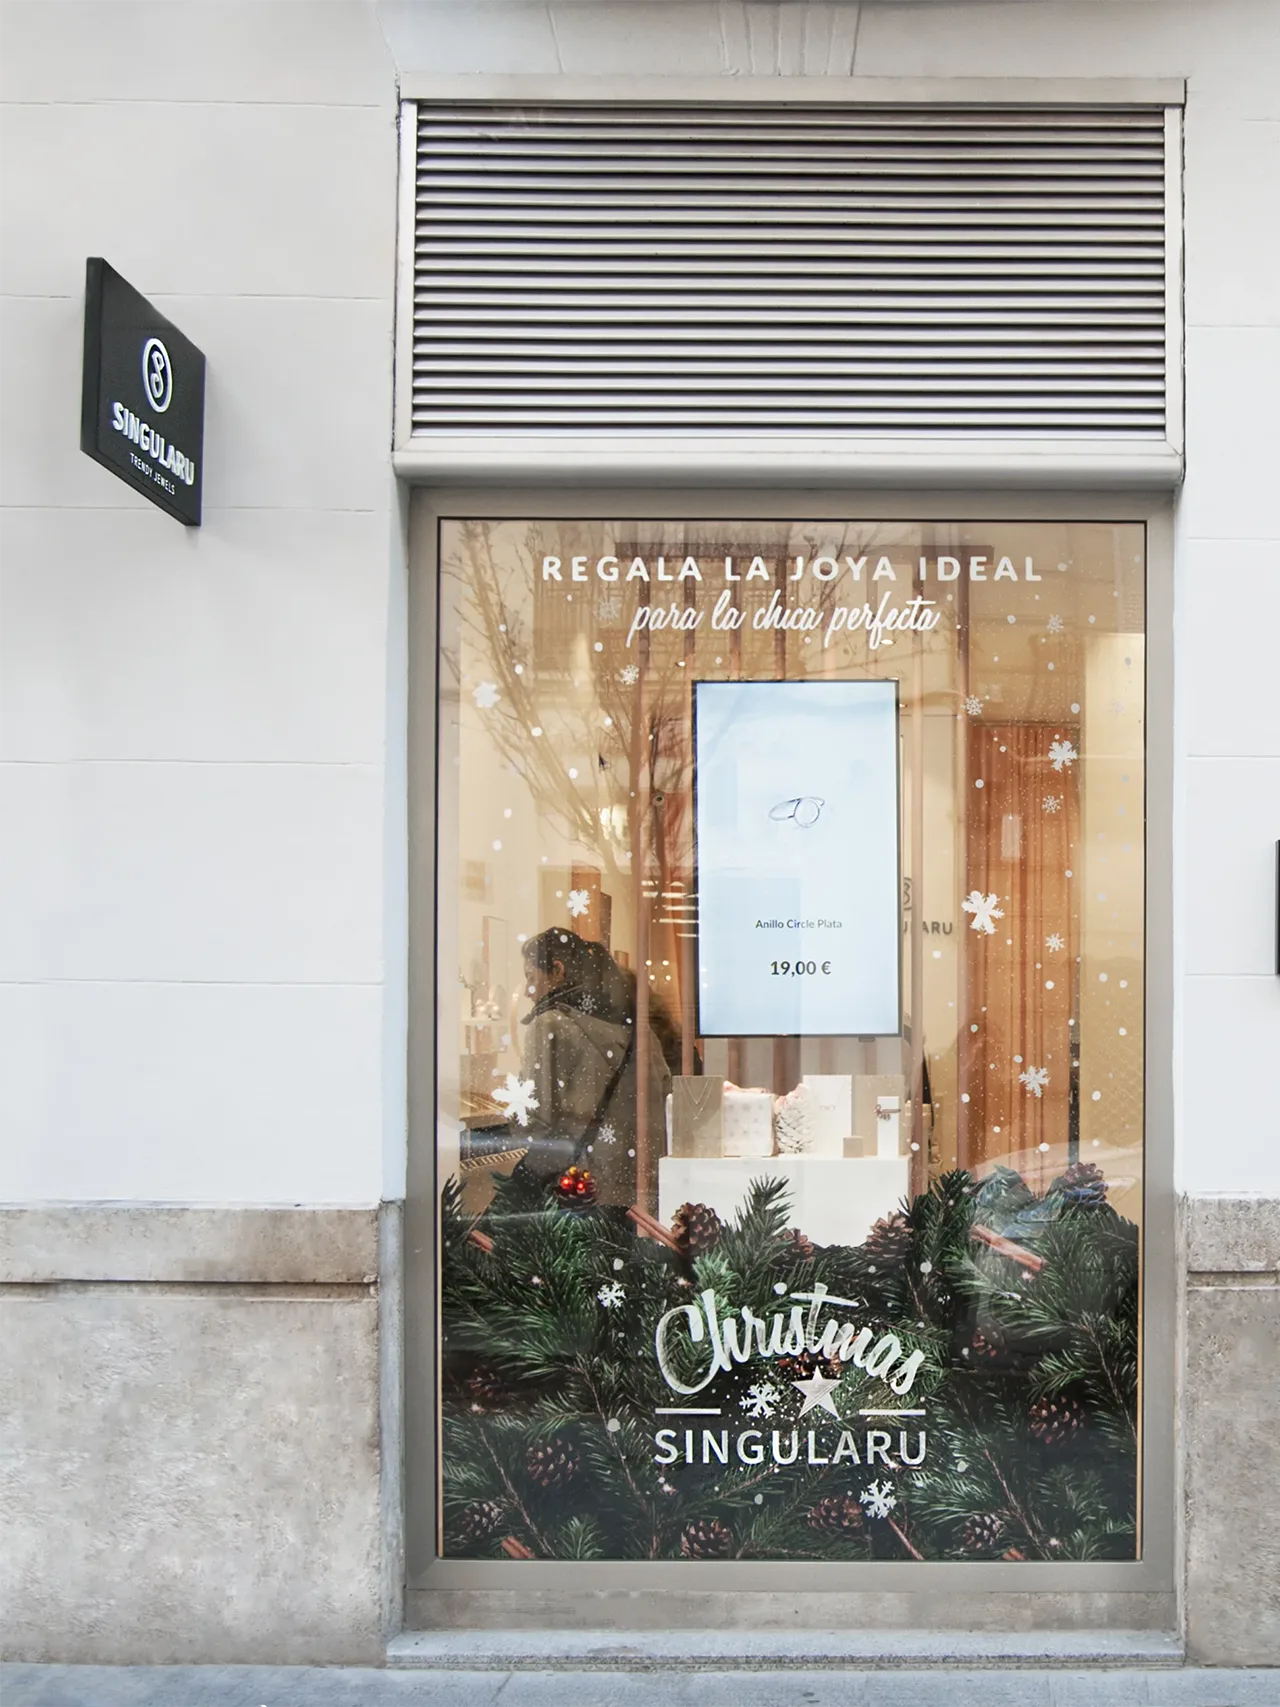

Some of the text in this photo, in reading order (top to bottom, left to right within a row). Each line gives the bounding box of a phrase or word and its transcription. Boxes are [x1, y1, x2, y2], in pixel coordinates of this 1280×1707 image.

[112, 401, 195, 486] SINGULARU
[130, 452, 175, 495] TRENDY JEWELS
[542, 556, 1042, 582] REGALA LA JOYA IDEAL
[626, 590, 942, 649] para la chica perfecta
[755, 919, 843, 929] Anillo Circle Plata
[770, 960, 832, 978] 19,00 €
[655, 1282, 925, 1395] Christmas
[653, 1429, 927, 1465] SINGULARU
